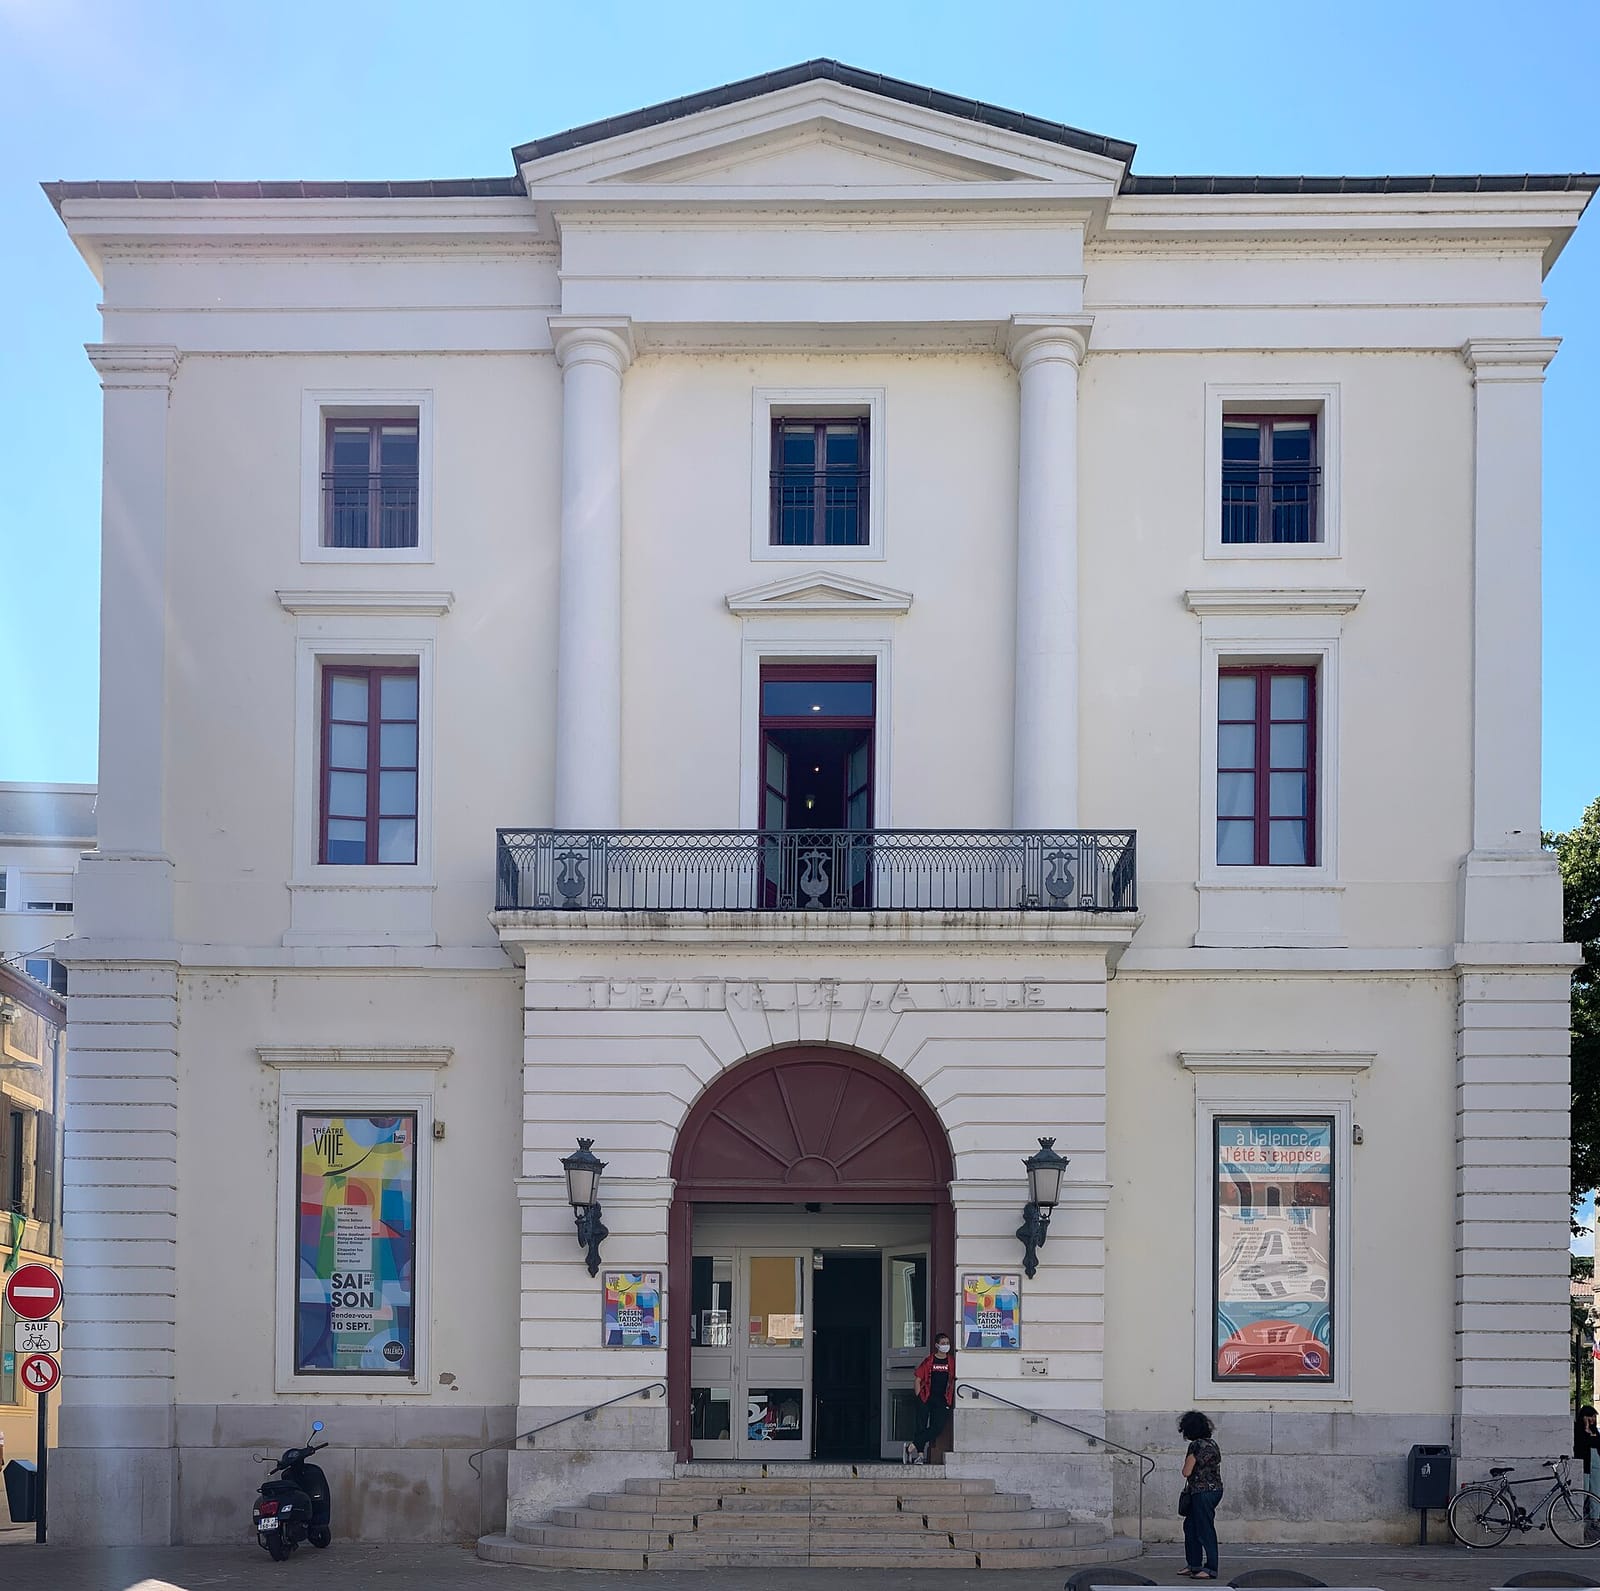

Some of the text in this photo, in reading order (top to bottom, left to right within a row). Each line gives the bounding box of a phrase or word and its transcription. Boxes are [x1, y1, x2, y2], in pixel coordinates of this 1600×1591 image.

[1236, 1129, 1245, 1146] à
[1226, 1146, 1321, 1165] l'été s'expose
[332, 1292, 373, 1308] SON
[24, 1323, 48, 1331] SAUF
[332, 1322, 371, 1331] 10 SEPT.
